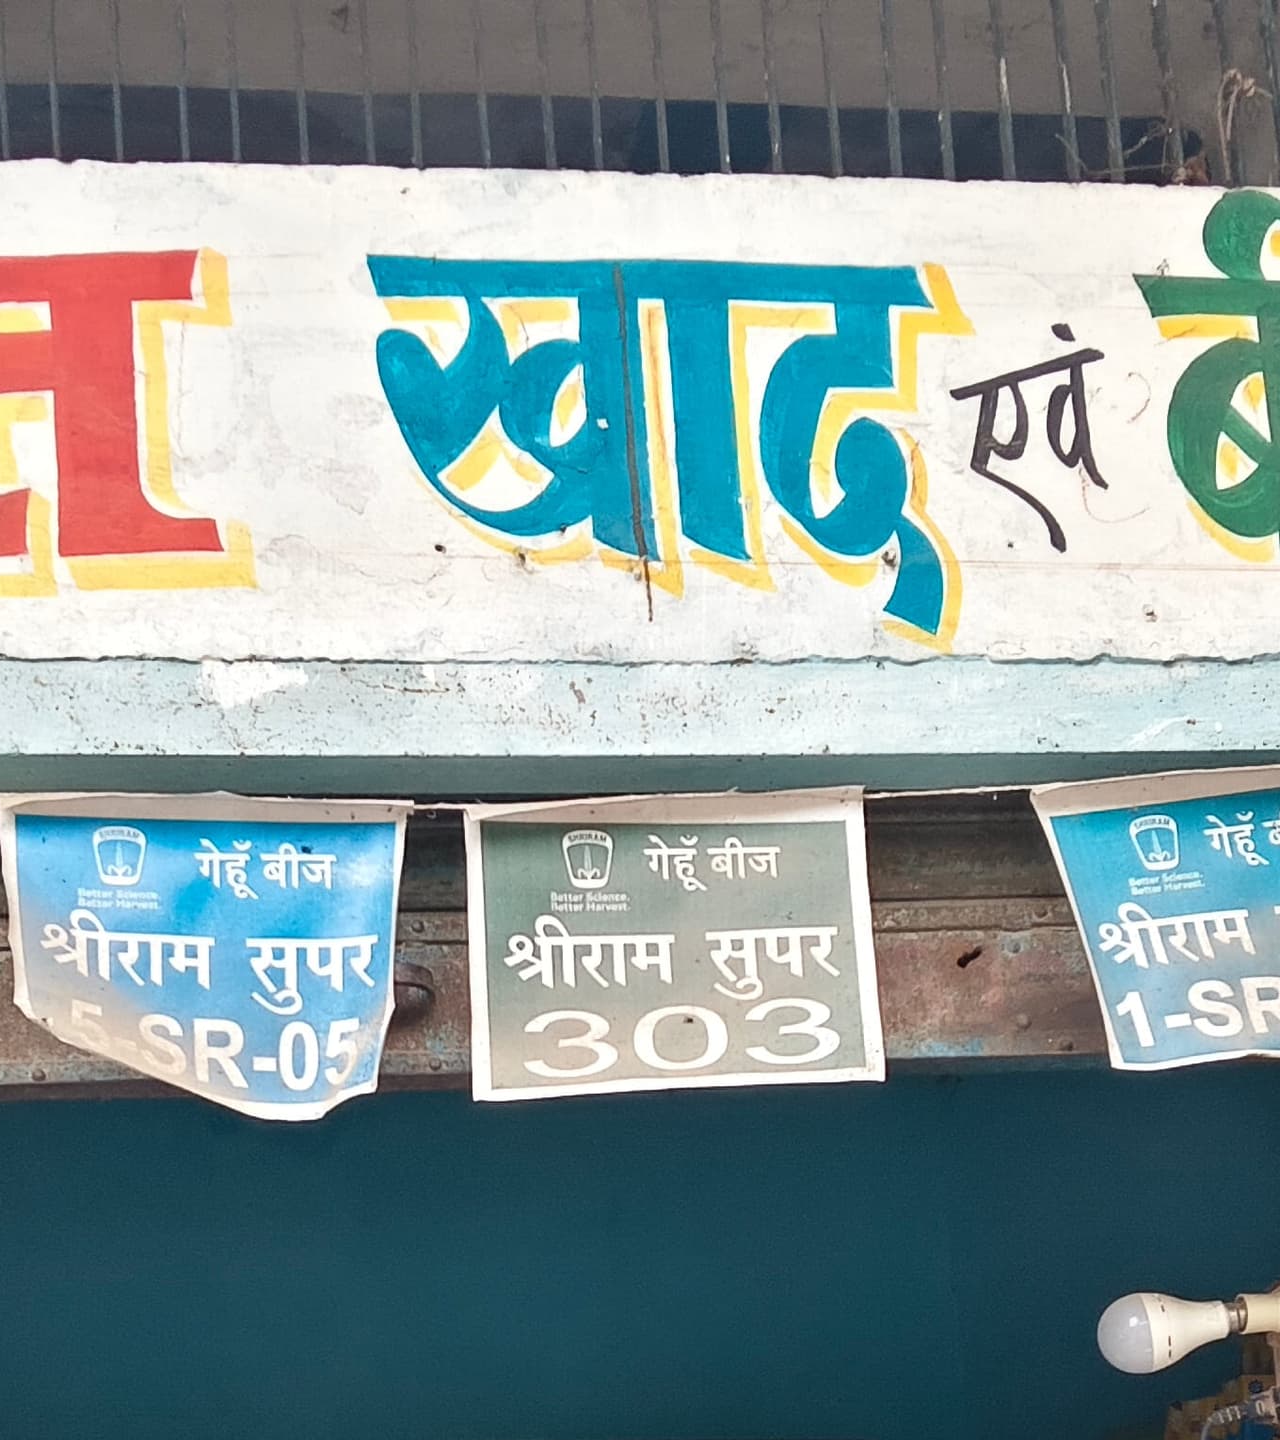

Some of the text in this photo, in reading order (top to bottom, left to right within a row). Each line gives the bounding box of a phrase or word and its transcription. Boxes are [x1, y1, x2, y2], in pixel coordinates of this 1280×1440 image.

[367, 252, 960, 642] खाद
[951, 322, 1107, 554] एवं
[261, 843, 337, 889] बीज
[706, 836, 781, 880] बीज
[40, 908, 379, 1016] श्रीराम सुपर
[503, 914, 841, 1000] श्रीराम सुपर
[1098, 901, 1257, 969] श्रीराम
[523, 997, 841, 1078] 303
